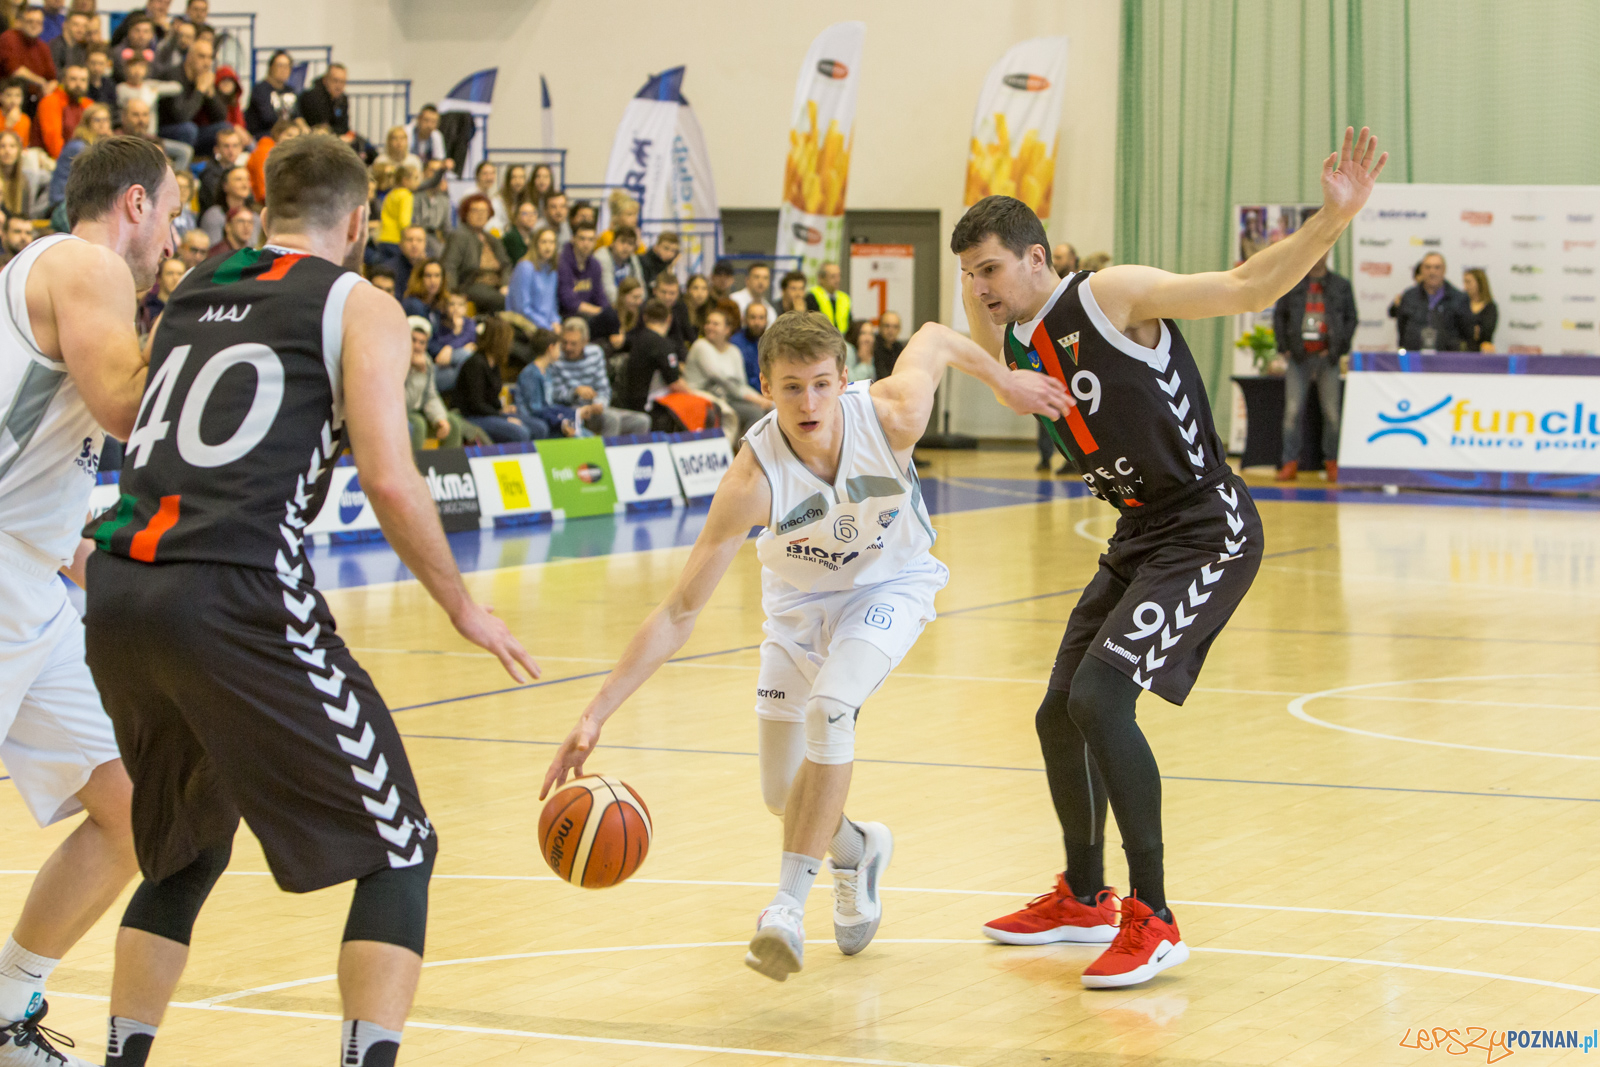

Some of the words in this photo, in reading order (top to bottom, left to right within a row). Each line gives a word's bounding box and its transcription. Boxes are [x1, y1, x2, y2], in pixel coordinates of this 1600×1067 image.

[198, 304, 252, 322] MAJ
[125, 342, 285, 469] 40
[1071, 370, 1101, 416] 9
[1451, 435, 1524, 448] biuro
[833, 514, 859, 544] 6
[786, 552, 817, 563] POLSKI
[818, 558, 842, 572] PROD
[864, 602, 895, 631] 6
[1123, 601, 1165, 641] 9
[1103, 637, 1142, 665] hummel
